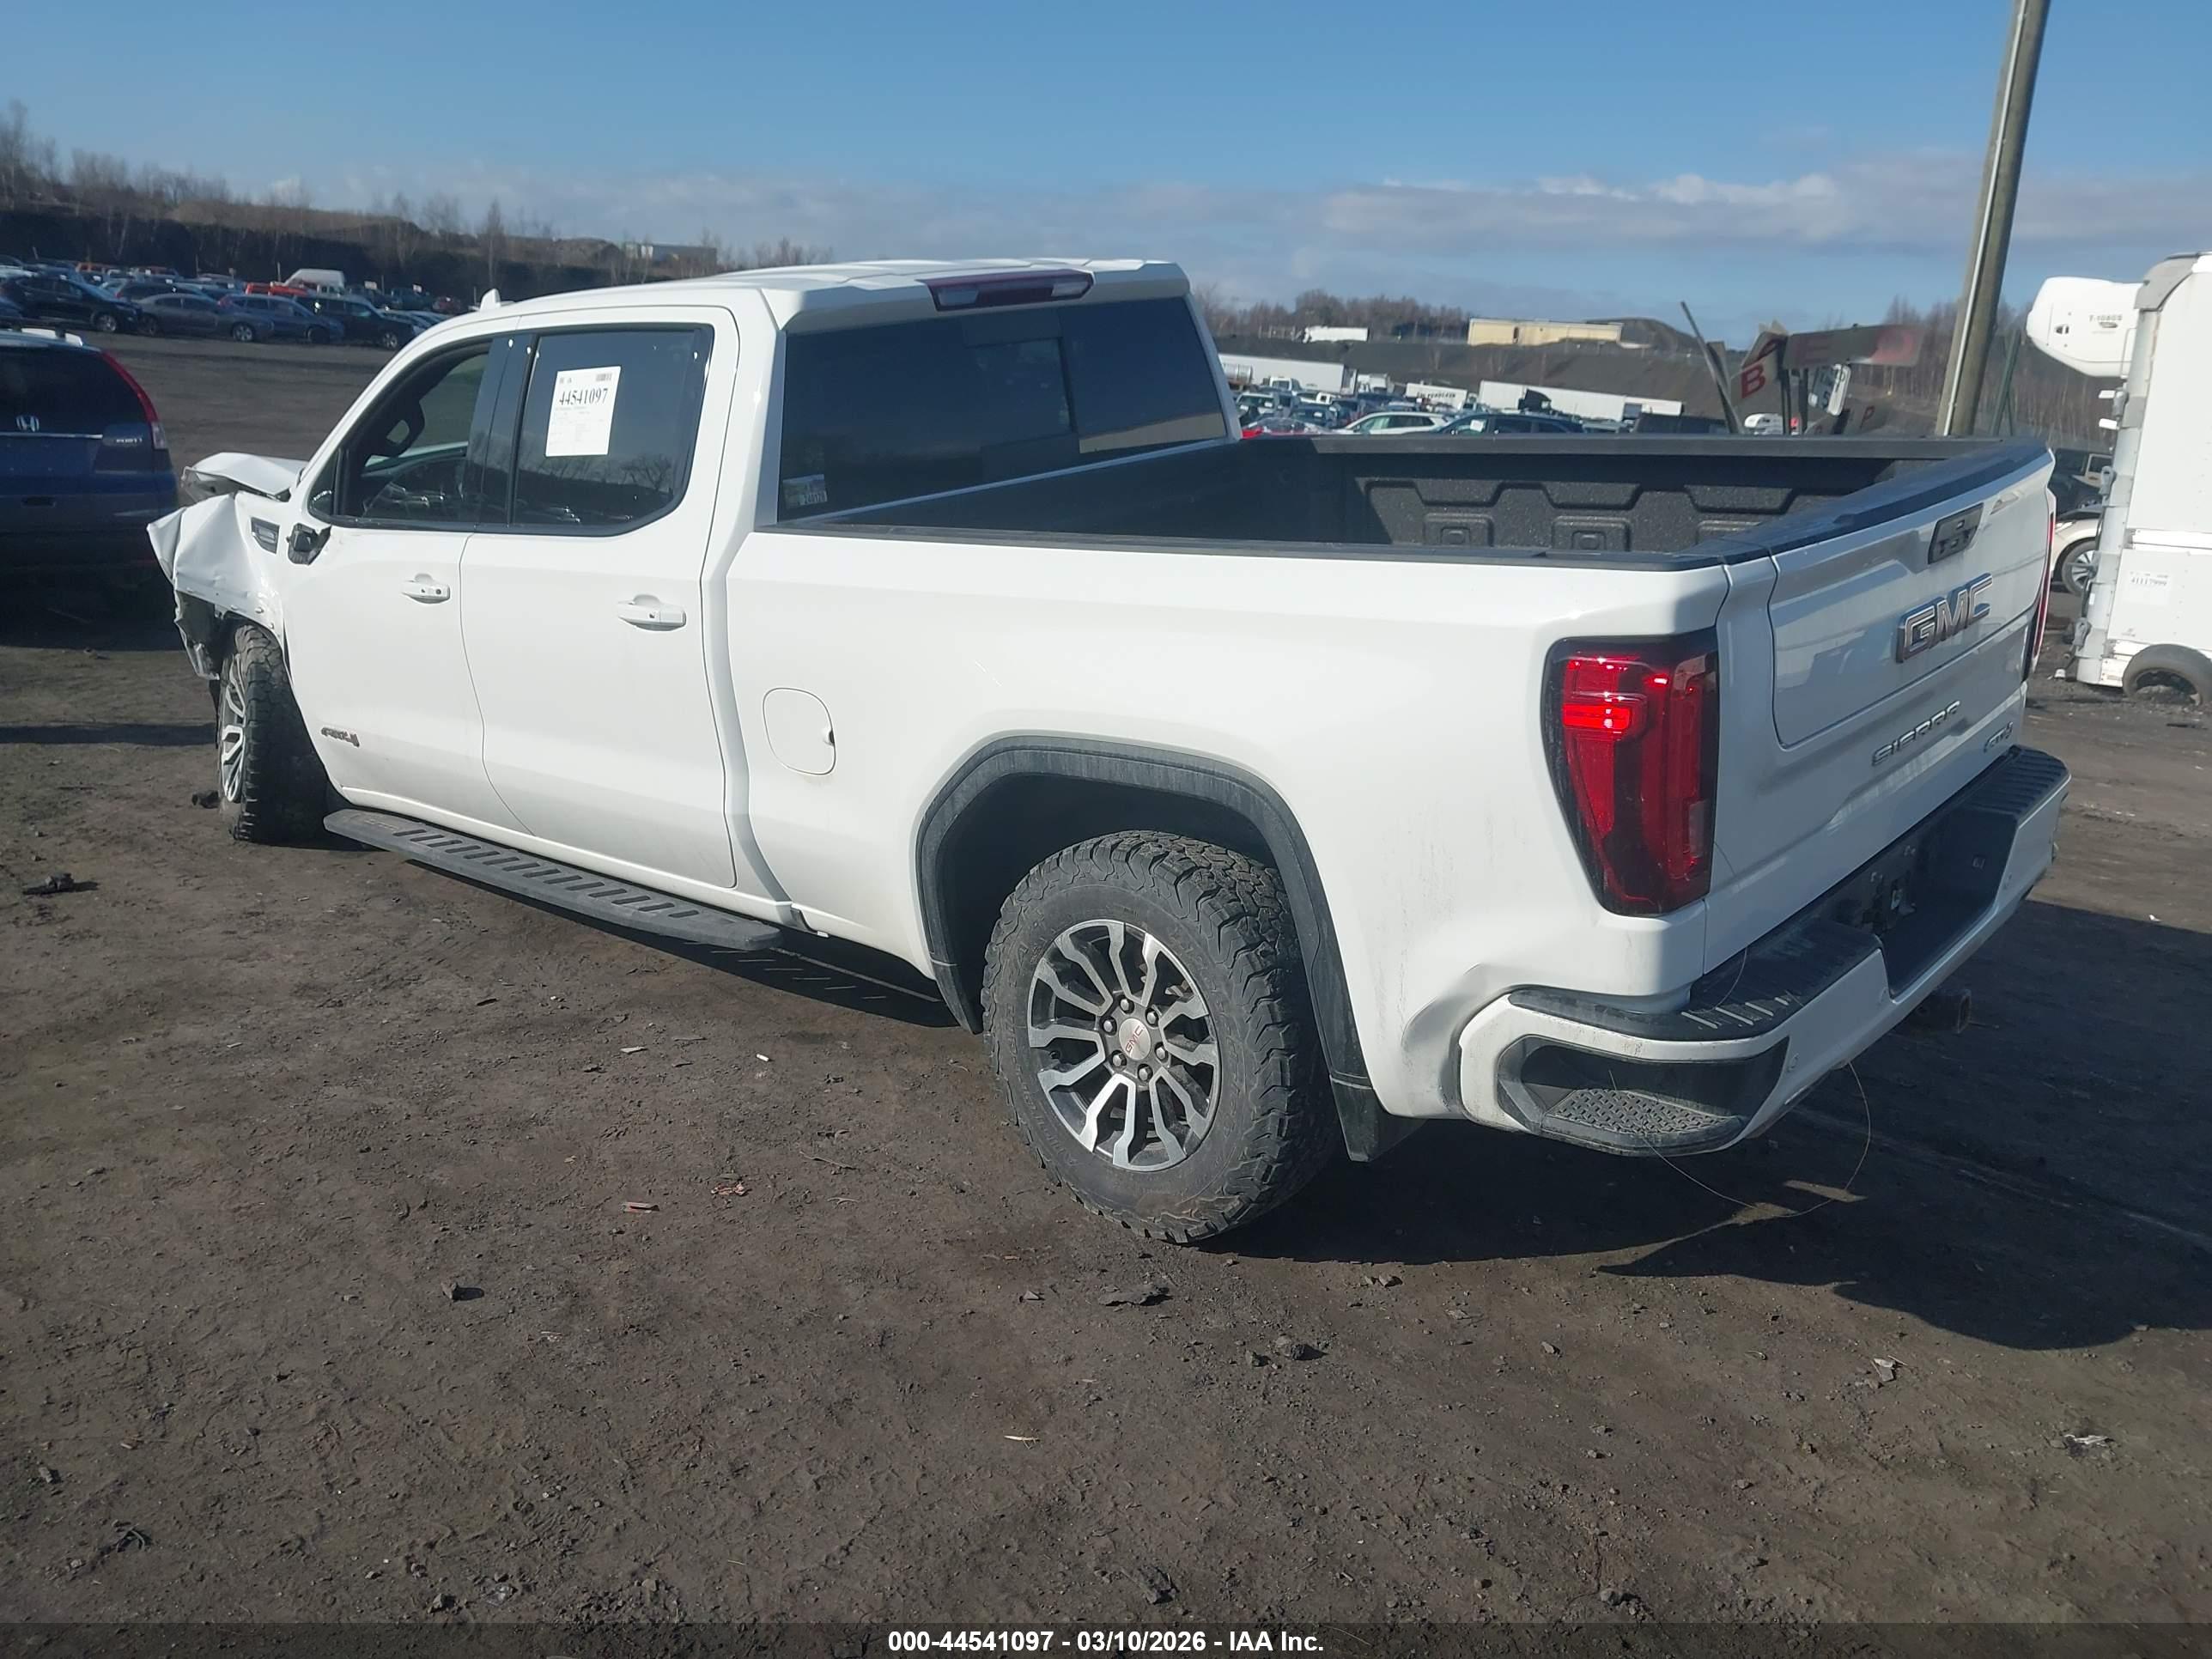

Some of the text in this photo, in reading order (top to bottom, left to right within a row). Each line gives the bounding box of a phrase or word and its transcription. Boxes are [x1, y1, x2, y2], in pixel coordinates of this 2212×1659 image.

[559, 387, 608, 405] 44541097
[1896, 573, 1993, 663] GMC
[1871, 700, 1960, 766] SIERRA
[1125, 1025, 1144, 1054] GMC
